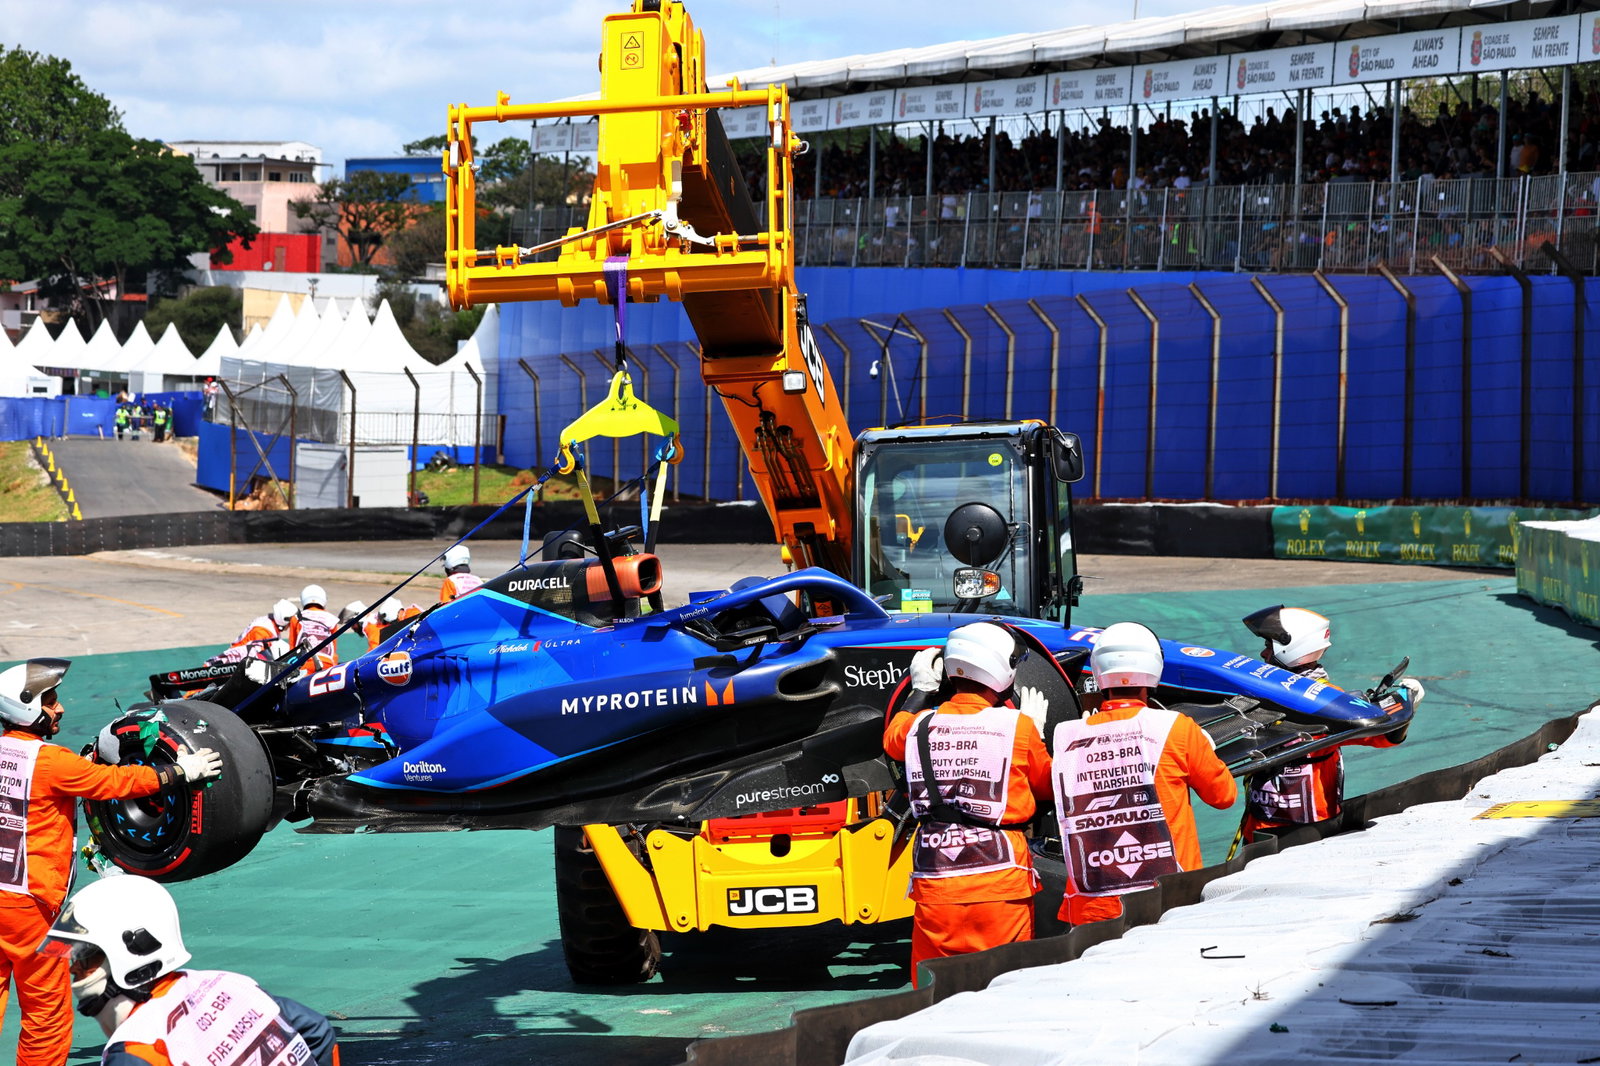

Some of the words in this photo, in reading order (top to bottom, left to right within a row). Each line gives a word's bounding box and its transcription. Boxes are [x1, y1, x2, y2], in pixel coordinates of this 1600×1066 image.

[1533, 25, 1559, 40] SEMPRE
[1413, 37, 1444, 52] ALWAYS
[1484, 36, 1503, 45] CIDADE
[1361, 49, 1372, 58] CITY
[1483, 48, 1496, 60] SÃO
[1496, 47, 1516, 59] PAULO
[1532, 46, 1542, 59] NA
[1544, 42, 1569, 57] FRENTE
[1290, 52, 1315, 66] SEMPRE
[1360, 60, 1374, 72] SÃO
[1375, 59, 1394, 70] PAULO
[1412, 54, 1438, 69] AHEAD
[1193, 63, 1217, 76] ALWAYS
[1289, 71, 1300, 82] NA
[1301, 66, 1324, 80] FRENTE
[1192, 79, 1213, 91] AHEAD
[1247, 73, 1257, 84] SÃO
[1258, 72, 1275, 83] PAULO
[1286, 540, 1325, 555] ROLEX
[1346, 541, 1382, 557] ROLEX
[1400, 544, 1436, 560] ROLEX
[1452, 545, 1479, 561] ROLEX
[508, 577, 570, 592] DURACELL
[544, 639, 581, 648] ULTRA
[180, 665, 237, 680] MoneyGram
[380, 662, 410, 675] Gulf
[561, 686, 697, 715] MYPROTEIN
[1087, 746, 1142, 763] 0283-BRA
[404, 773, 433, 782] Ventures
[952, 768, 991, 778] MARSHAL
[1077, 762, 1151, 782] INTERVENTION
[960, 785, 973, 794] FIA
[1093, 775, 1143, 791] MARSHAL
[736, 780, 824, 808] purestream
[1133, 793, 1148, 803] FIA
[1075, 816, 1105, 830] SÃO
[921, 828, 993, 848] COURSE
[1088, 841, 1172, 867] COURSE
[730, 887, 815, 914] JCB
[207, 1040, 233, 1066] FIRE
